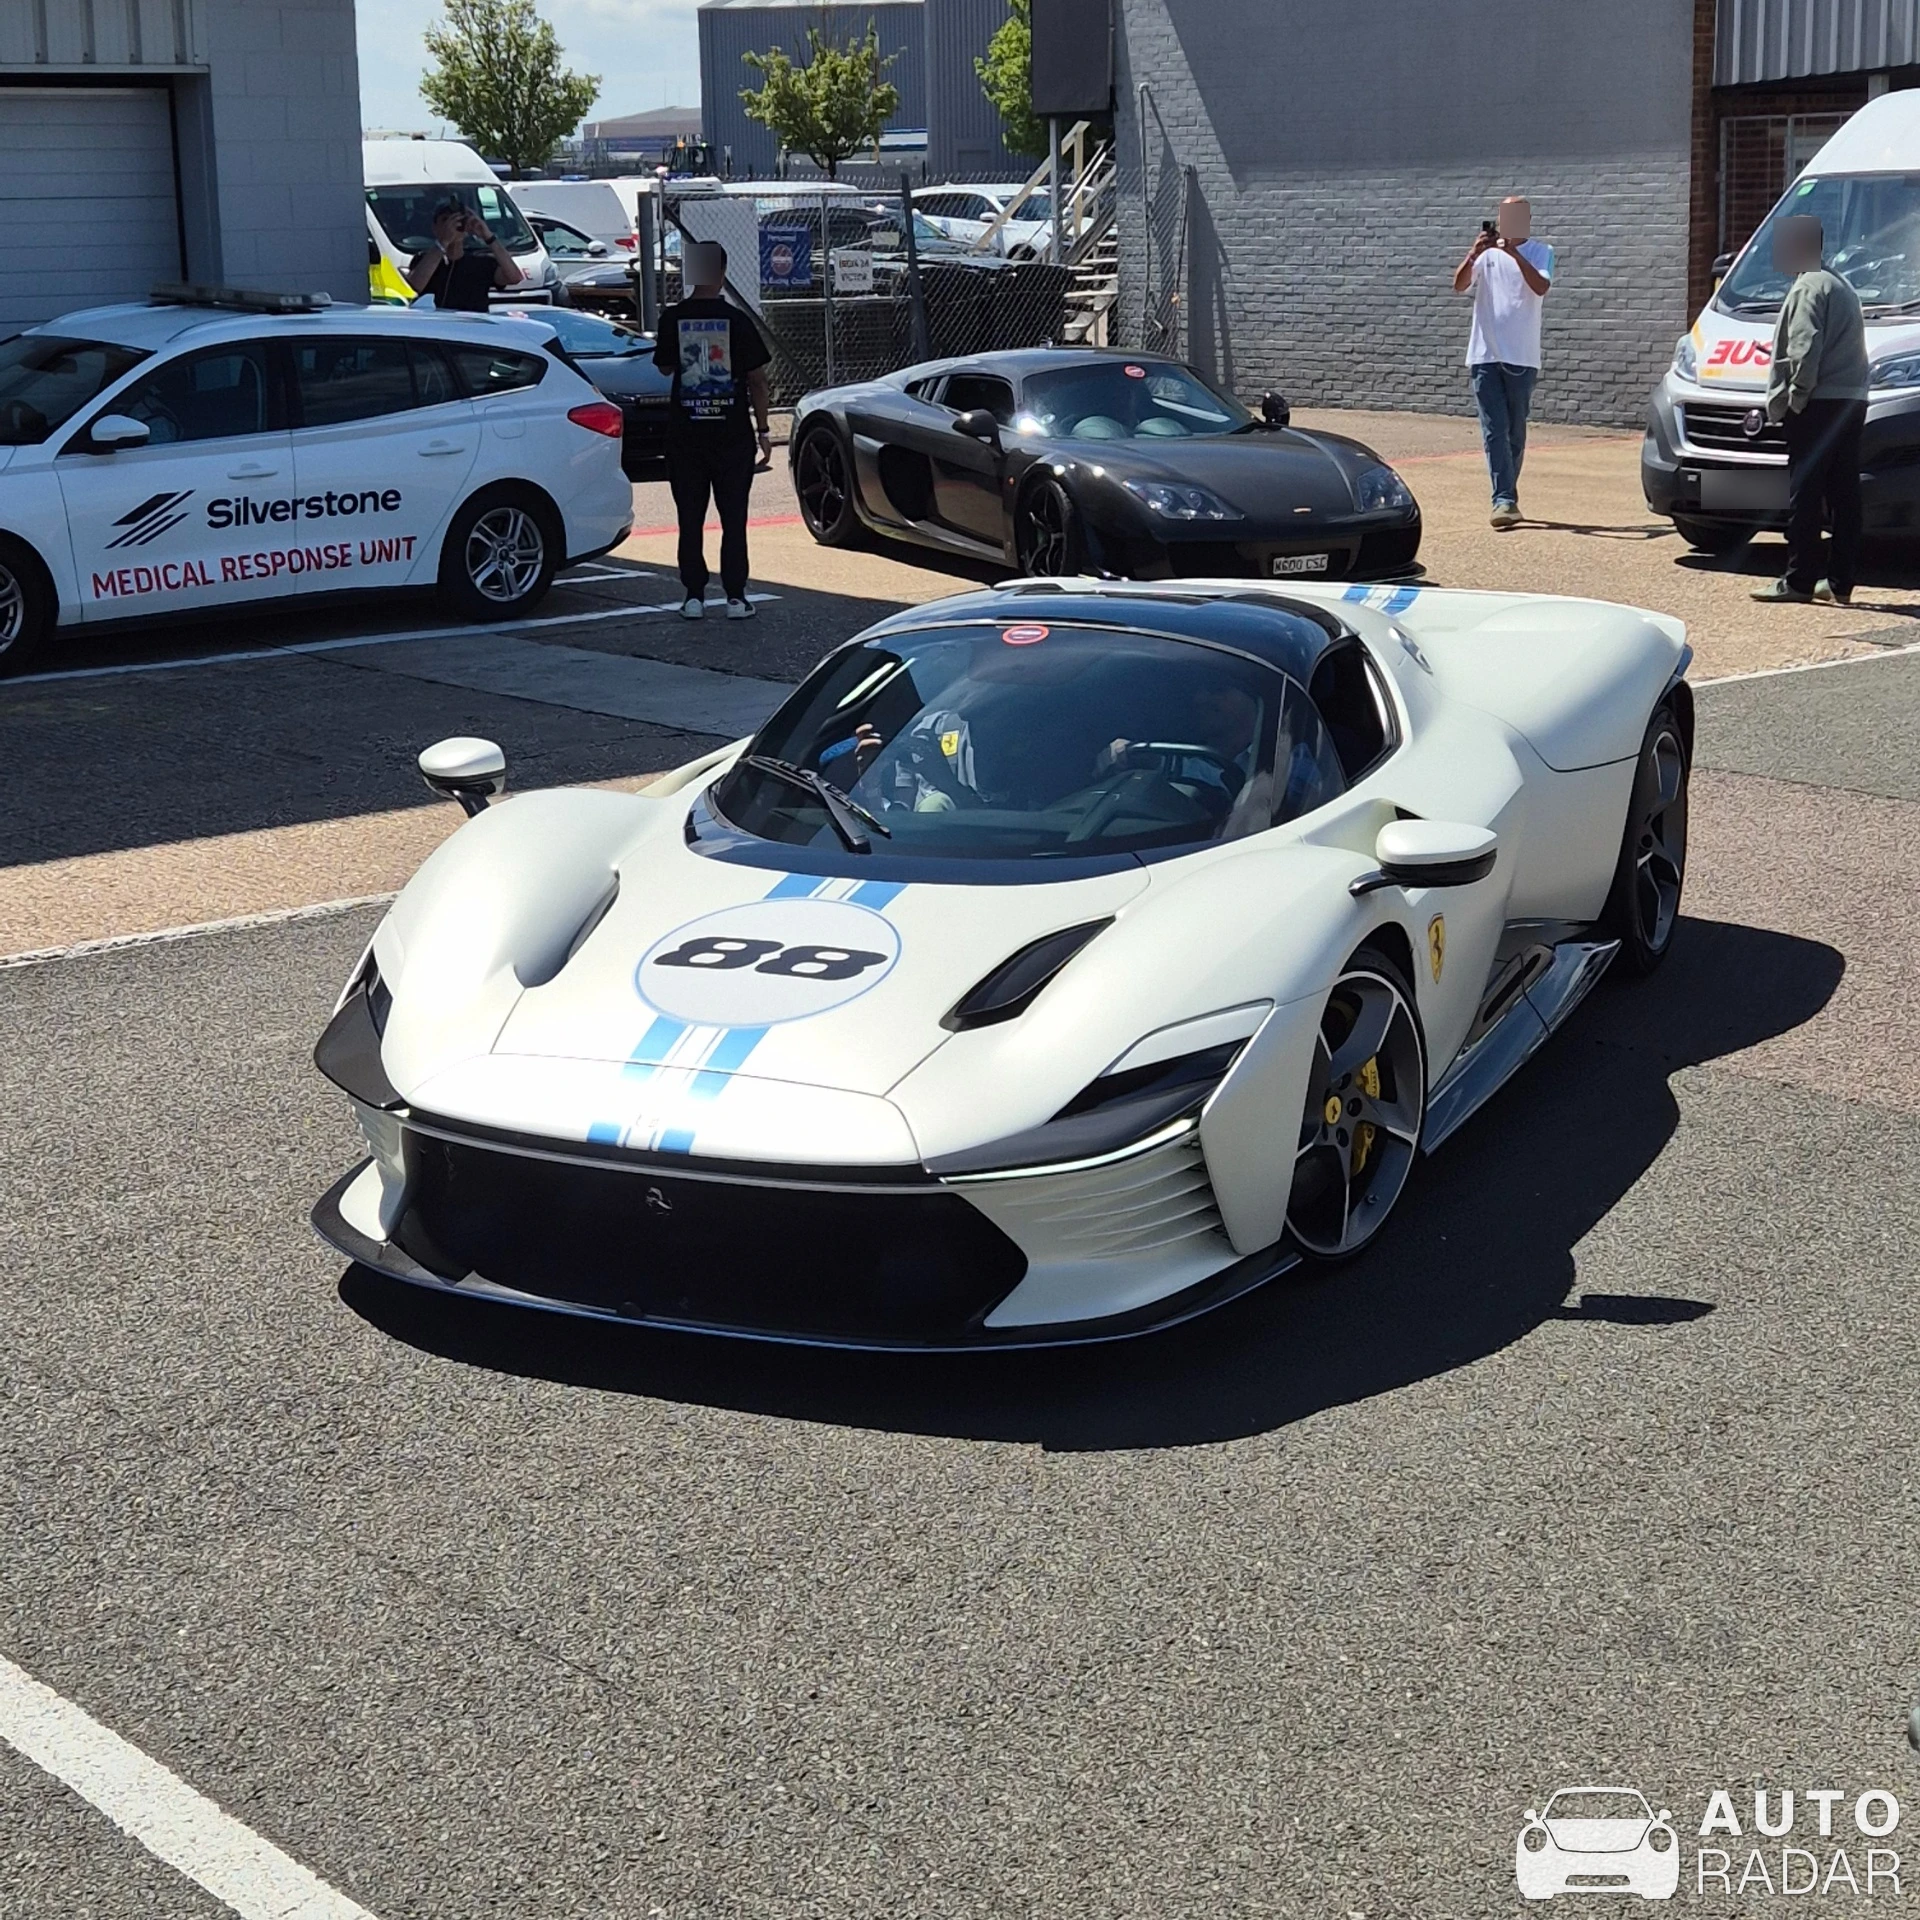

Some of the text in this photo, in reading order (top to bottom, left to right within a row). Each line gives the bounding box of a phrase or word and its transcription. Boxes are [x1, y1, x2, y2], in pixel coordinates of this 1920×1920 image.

[206, 489, 402, 530] Silverstone
[92, 536, 418, 600] MEDICAL RESPONSE UNIT
[653, 936, 889, 981] 88
